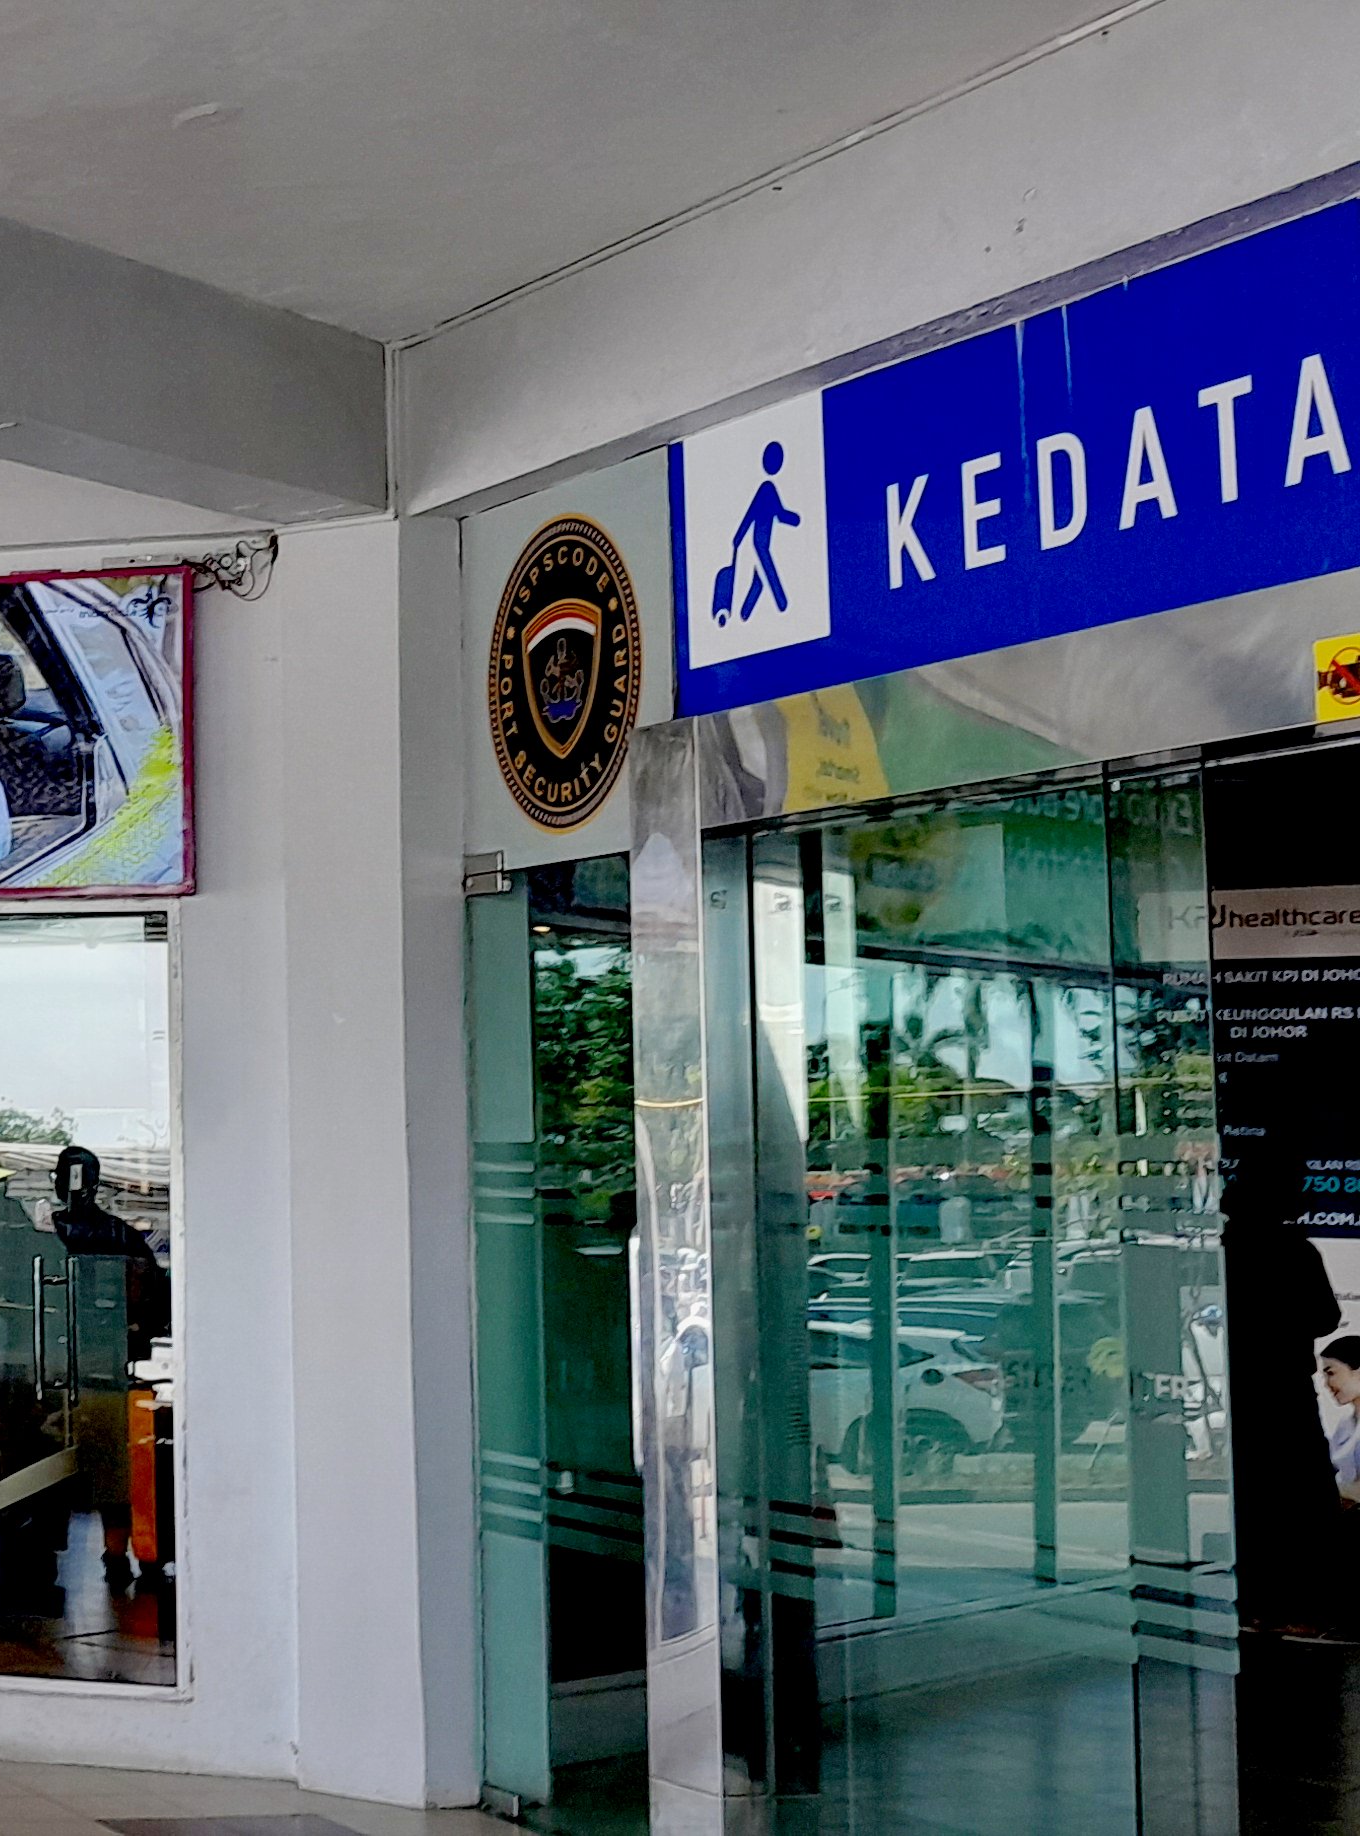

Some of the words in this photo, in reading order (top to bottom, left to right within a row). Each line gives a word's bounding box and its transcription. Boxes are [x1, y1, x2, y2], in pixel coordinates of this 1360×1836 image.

[885, 352, 1352, 591] KEDATA
[500, 653, 519, 737] PORT
[514, 750, 603, 804] SECURITY
[603, 622, 628, 744] GUARD
[1229, 1026, 1248, 1039] DI
[1250, 1025, 1308, 1039] JOHOR
